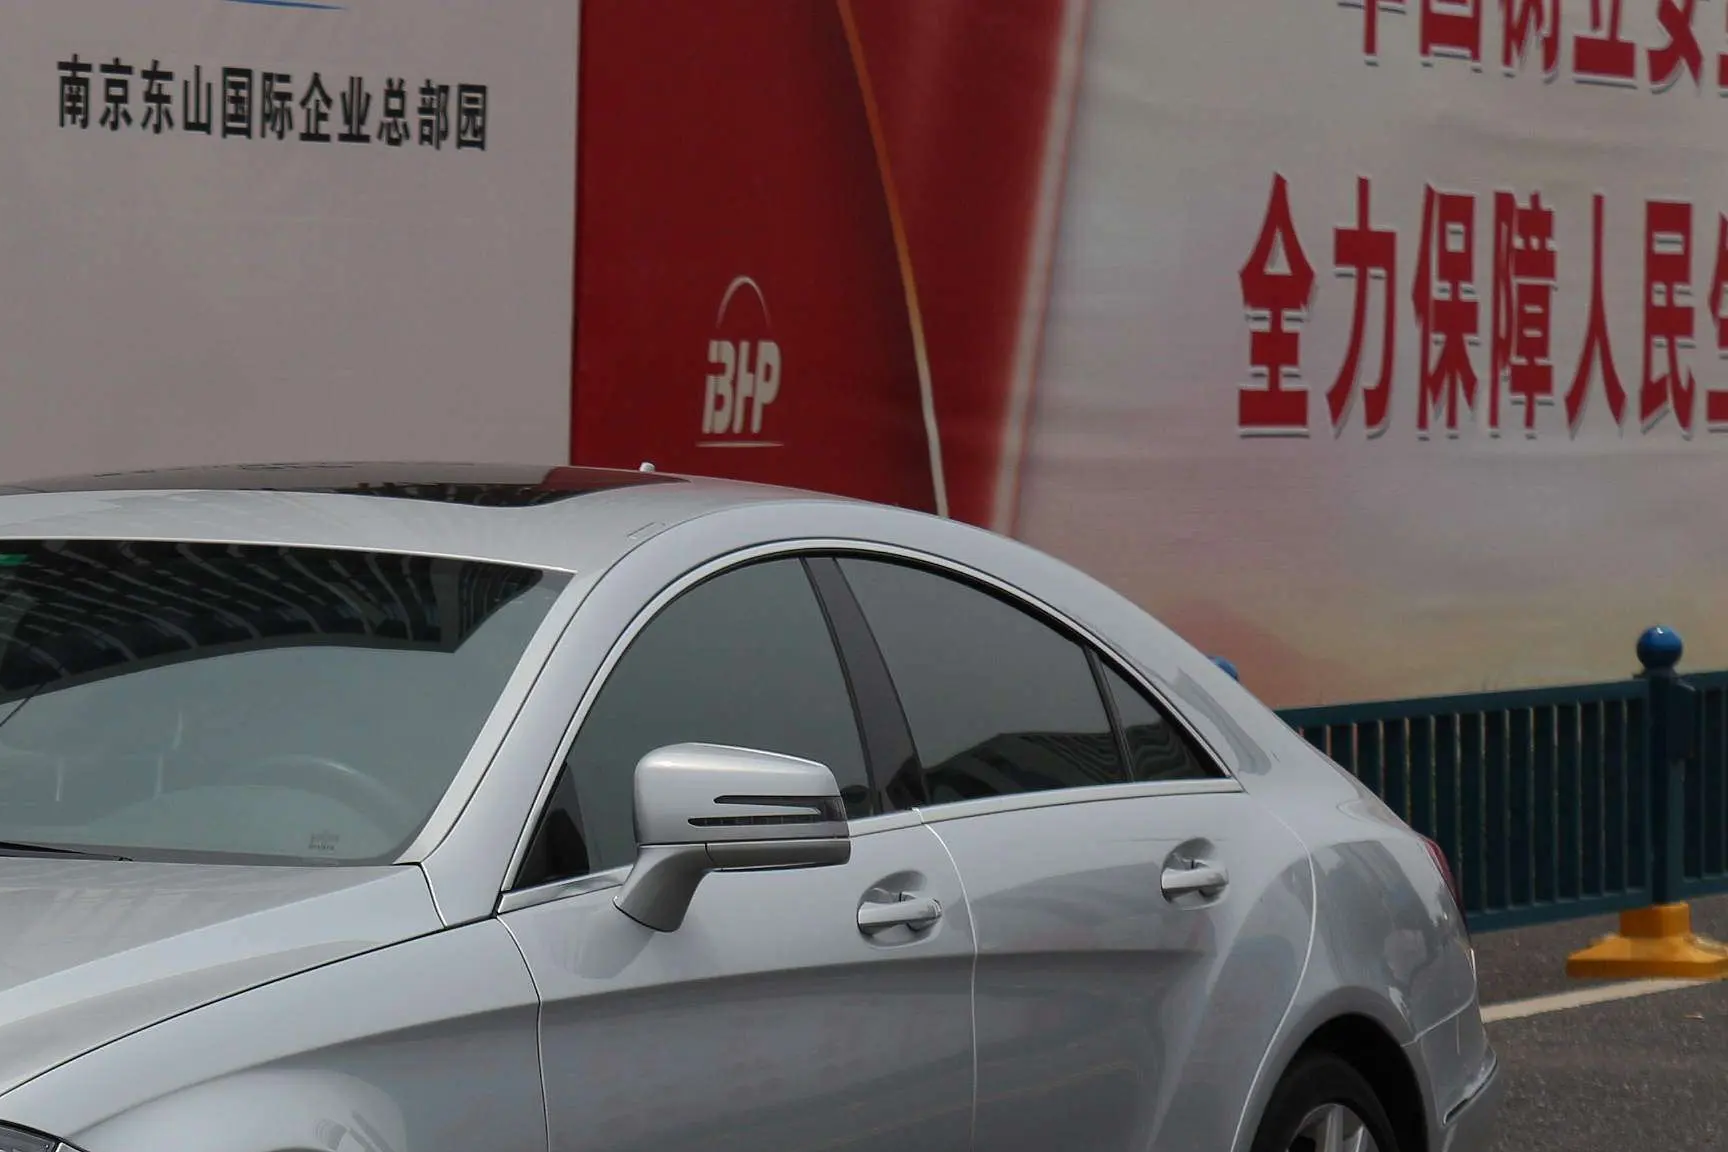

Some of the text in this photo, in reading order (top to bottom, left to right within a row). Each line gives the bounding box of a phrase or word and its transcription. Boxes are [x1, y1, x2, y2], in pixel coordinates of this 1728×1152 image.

[56, 54, 488, 152] 南京东山国际企业总部园
